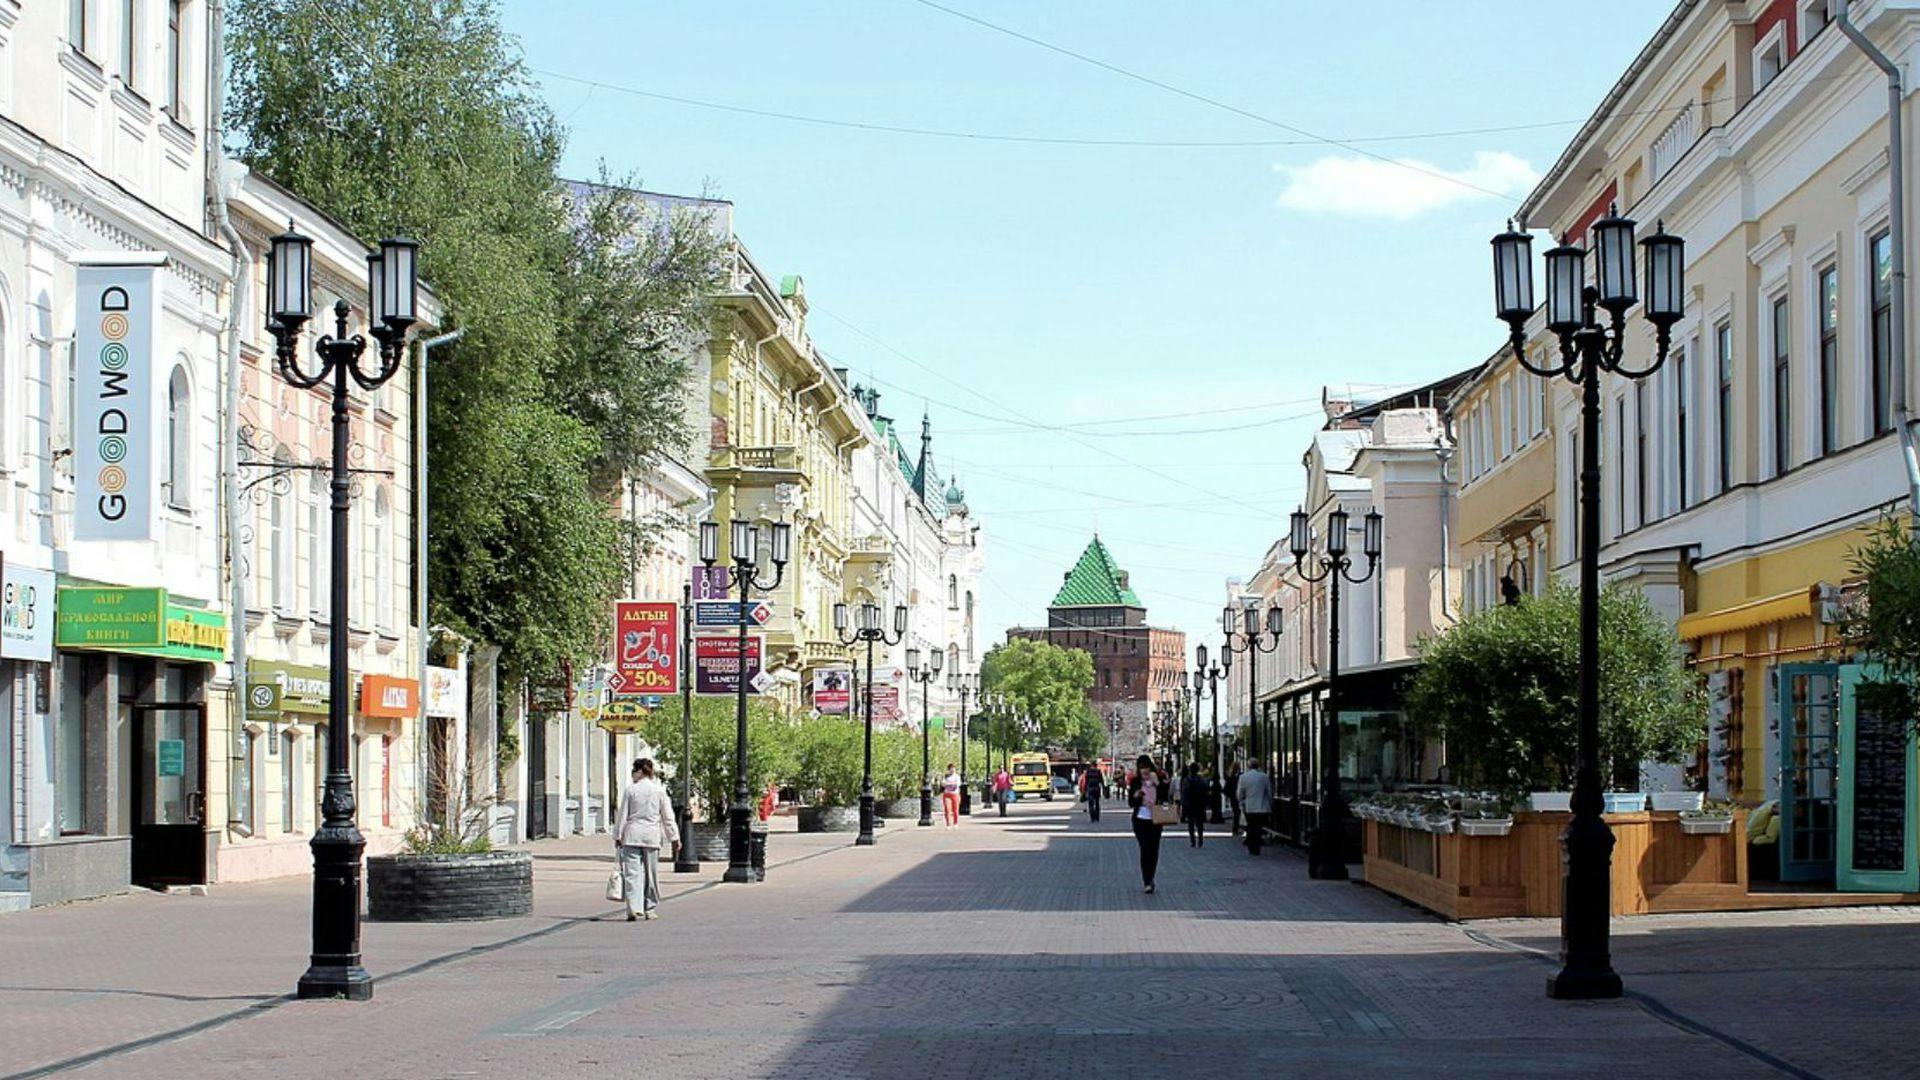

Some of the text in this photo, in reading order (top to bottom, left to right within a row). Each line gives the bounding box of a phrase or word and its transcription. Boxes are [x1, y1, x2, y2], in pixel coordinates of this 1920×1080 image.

[98, 285, 129, 522] GOOD WOOD
[623, 610, 669, 621] АЛТЫН
[634, 670, 671, 687] 50%
